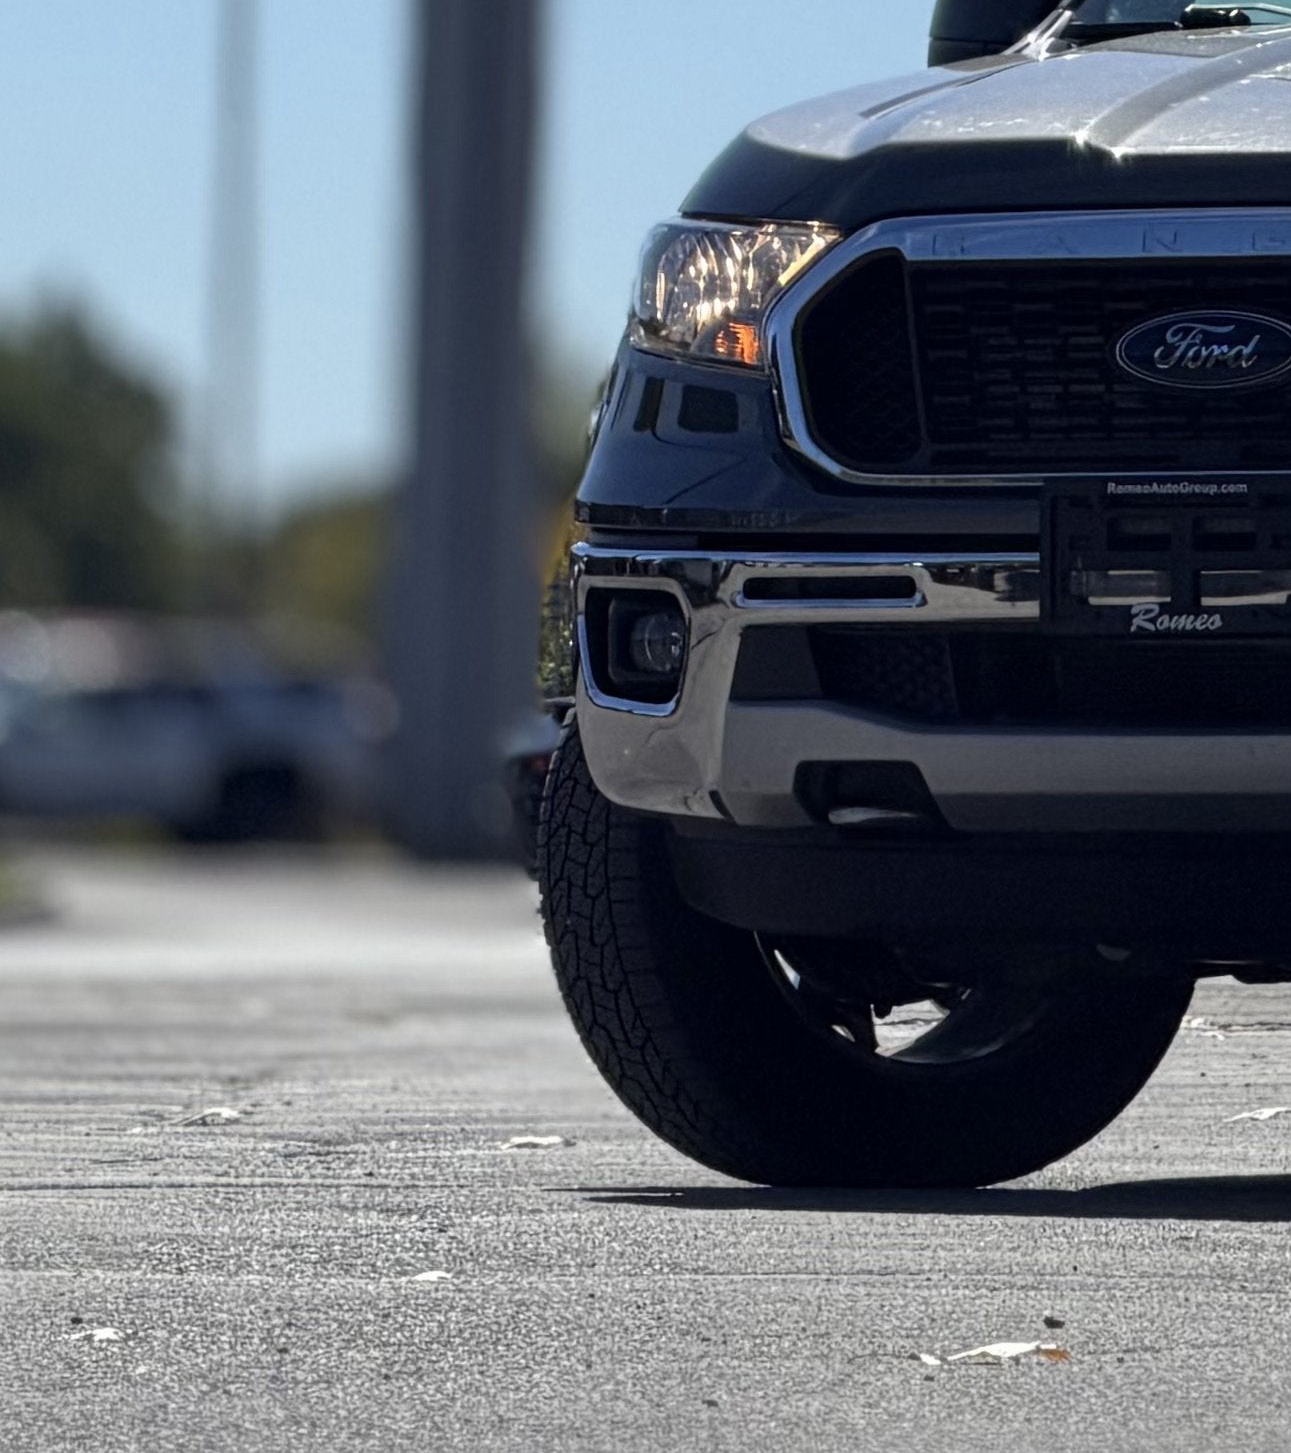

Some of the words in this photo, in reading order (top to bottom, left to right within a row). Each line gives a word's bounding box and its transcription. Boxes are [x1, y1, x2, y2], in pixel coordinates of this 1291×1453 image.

[1153, 322, 1261, 369] Ford
[1107, 481, 1248, 496] RomeoAutoGroup.com
[1129, 602, 1223, 633] Romeo
